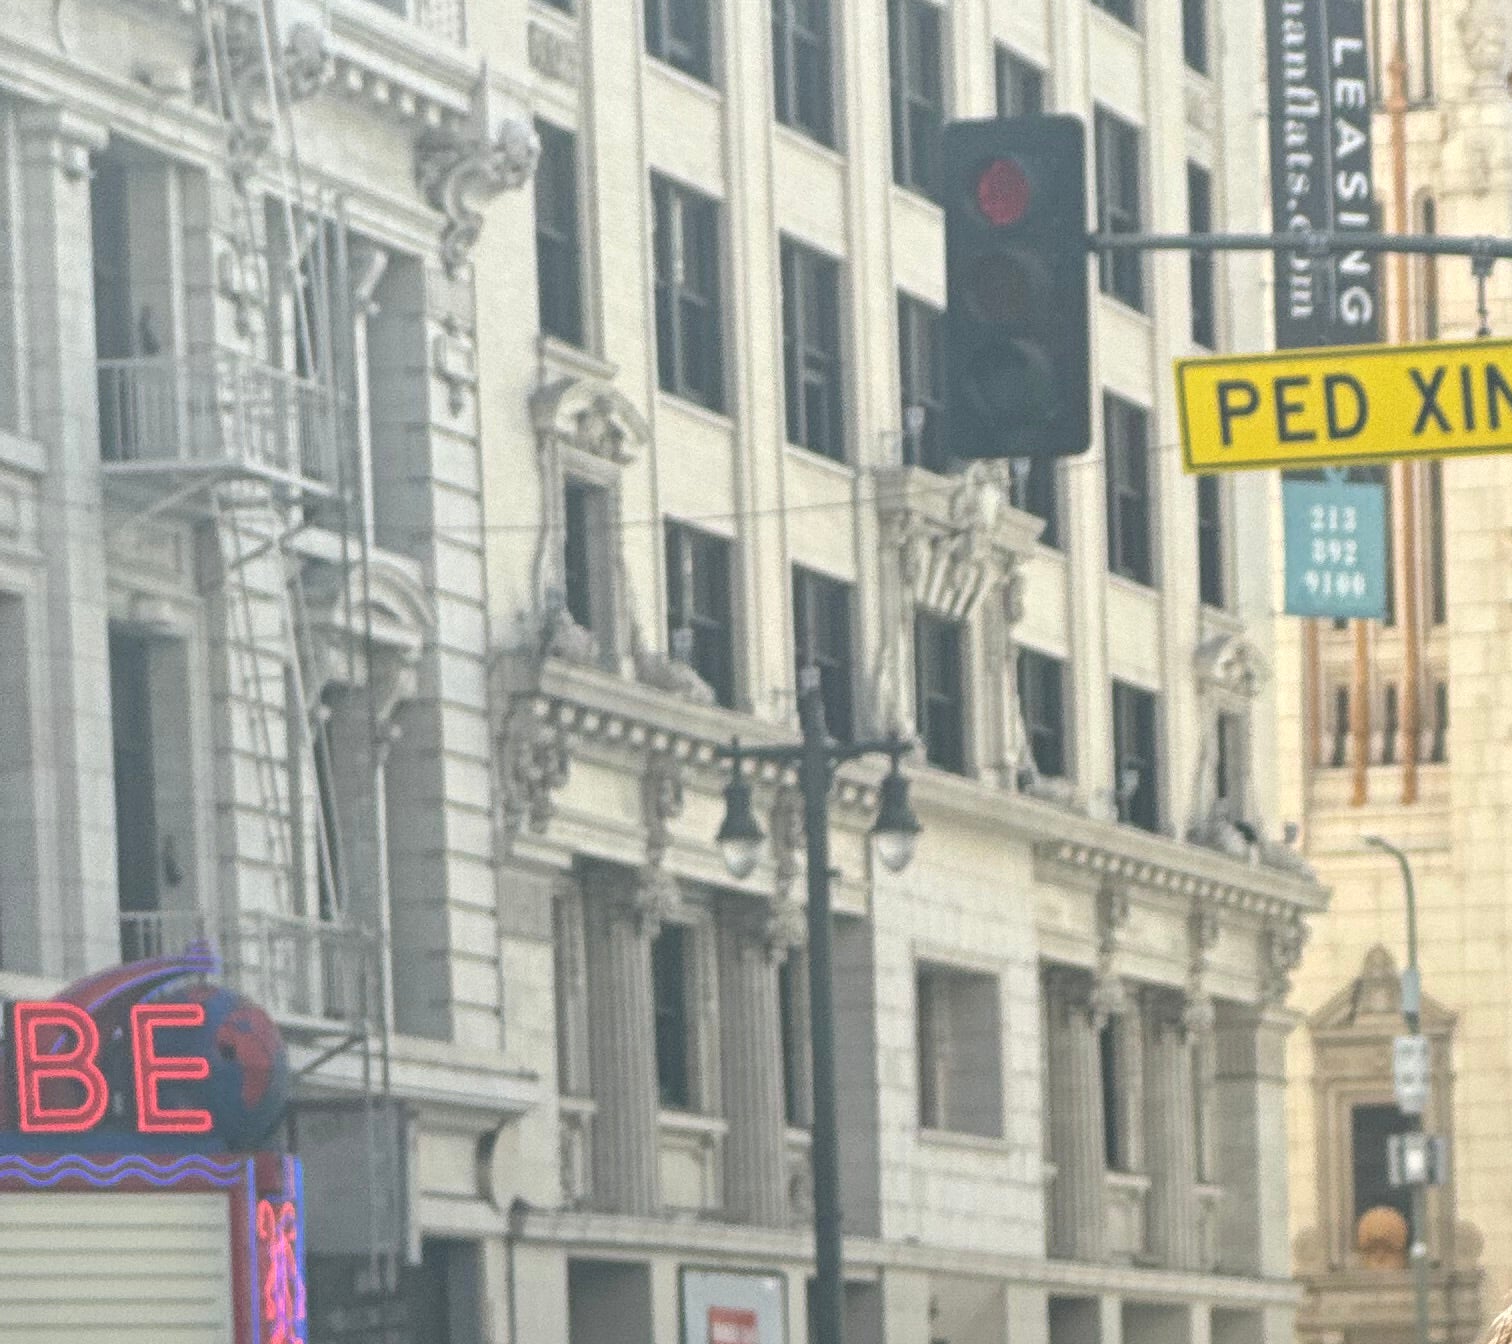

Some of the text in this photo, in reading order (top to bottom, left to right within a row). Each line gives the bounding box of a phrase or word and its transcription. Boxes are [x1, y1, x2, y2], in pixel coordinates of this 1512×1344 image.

[1331, 36, 1373, 326] LEASING
[1216, 371, 1369, 448] PED
[12, 1000, 214, 1134] BE
